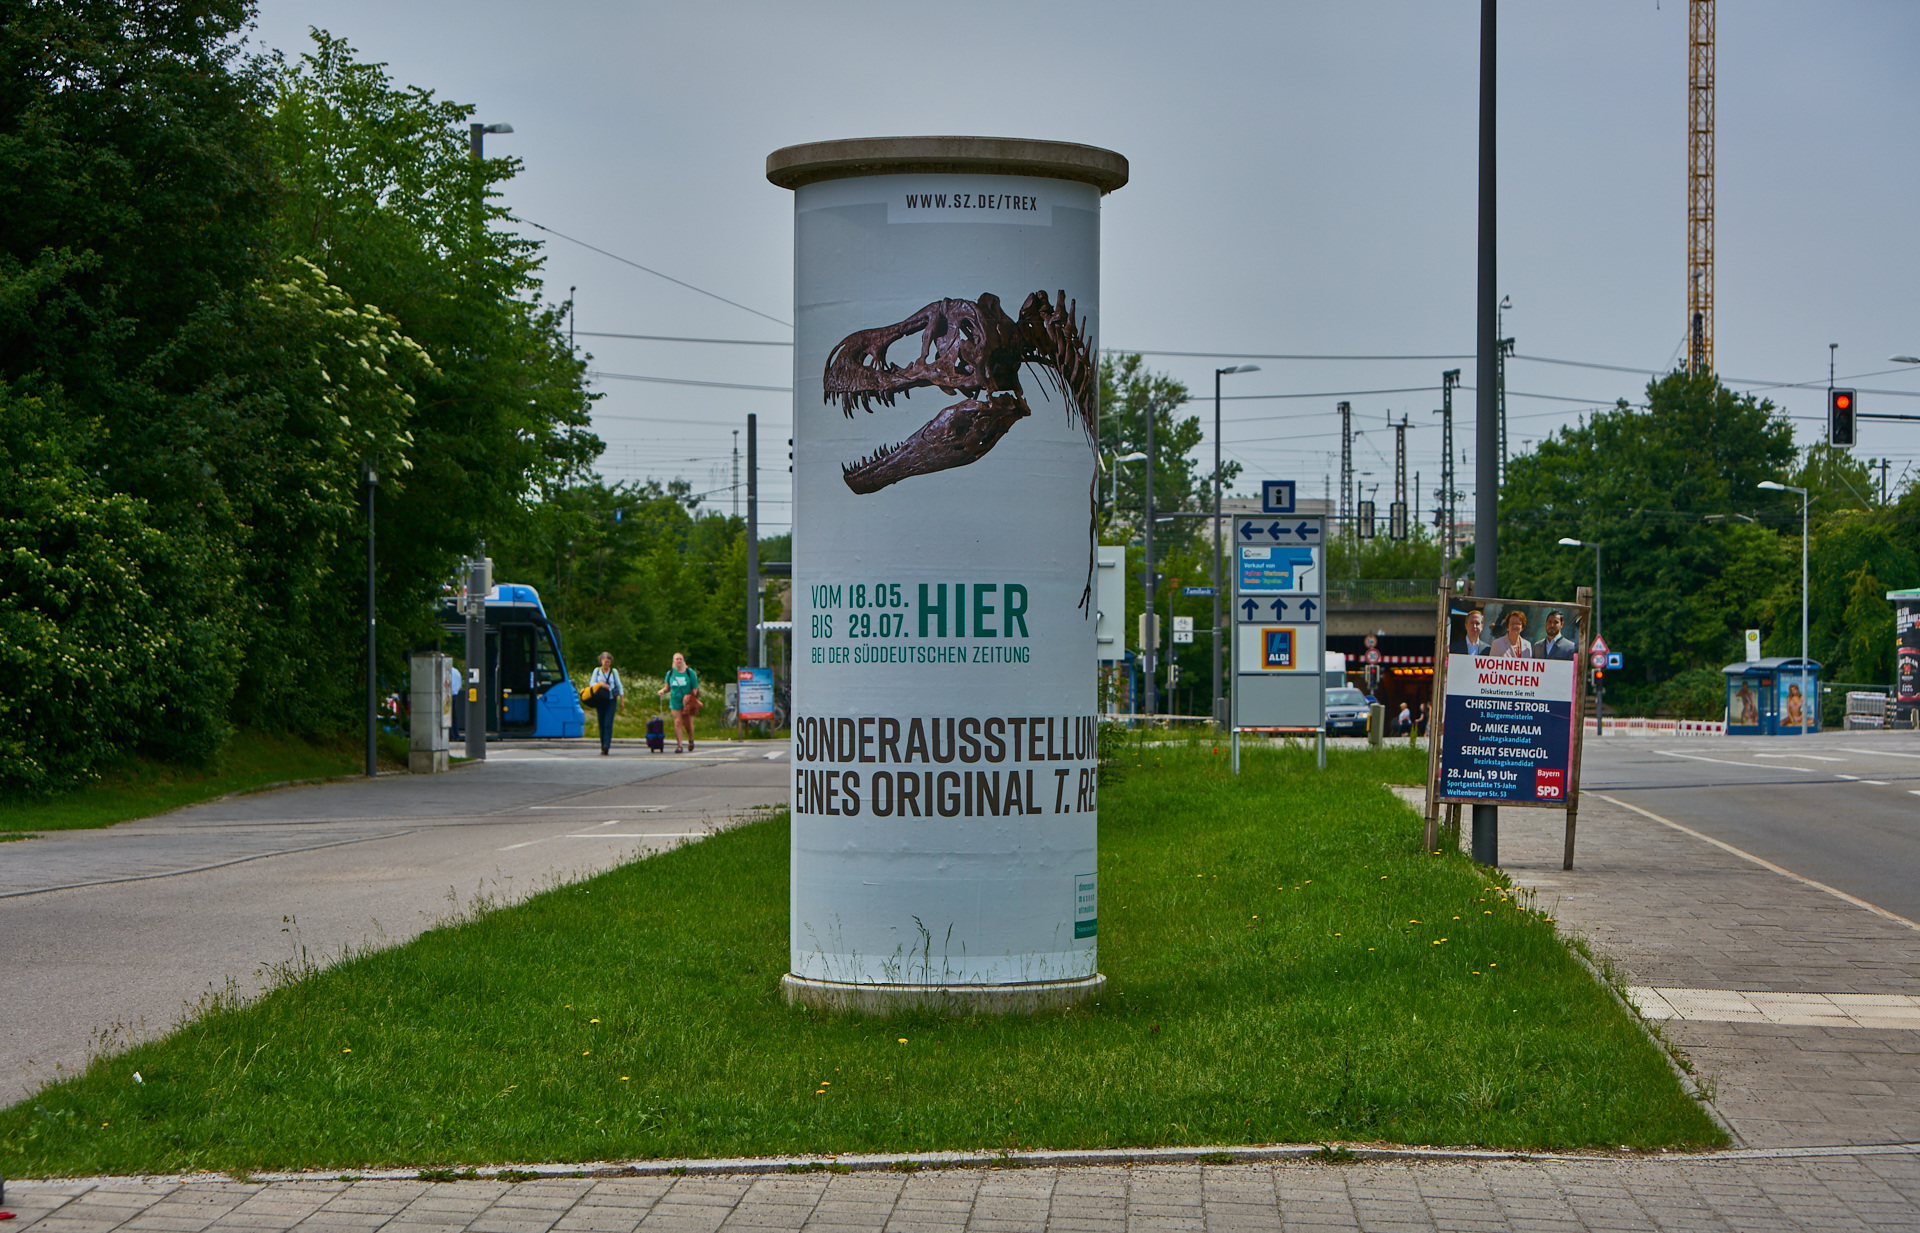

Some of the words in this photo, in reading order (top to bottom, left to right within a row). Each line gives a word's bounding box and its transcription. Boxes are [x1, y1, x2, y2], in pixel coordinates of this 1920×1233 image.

[906, 194, 1037, 211] WWW.SZ.DE/TREX
[811, 584, 842, 609] VOM
[849, 583, 909, 609] 18.05.
[918, 583, 1030, 638] HIER
[811, 614, 833, 638] BIS
[848, 613, 909, 638] 29.07.
[811, 647, 825, 664] BEI
[828, 647, 850, 663] DER
[854, 643, 967, 664] SÜDDEUTSCHEN
[972, 646, 1030, 664] ZEITUNG
[1269, 653, 1289, 661] ALDI
[1475, 658, 1529, 672] WOHNEN
[1532, 661, 1545, 673] IN
[1595, 656, 1604, 664] 30
[1478, 671, 1539, 687] MÜNCHEN
[1480, 688, 1513, 696] Diskutieren
[1465, 699, 1513, 710] CHRISTINE
[1514, 702, 1550, 712] STROBL
[1486, 712, 1533, 720] Bürgermeisterin
[1470, 723, 1483, 732] Dr.
[1485, 723, 1509, 733] MIKE
[1510, 725, 1542, 735] MALM
[1478, 735, 1531, 744] Landtagskandidat
[1461, 745, 1497, 756] SERHAT
[1498, 747, 1548, 759] SEVENGÜL
[1473, 758, 1534, 767] Bezirkstagskandidat
[1447, 768, 1461, 778] 28.
[1462, 769, 1485, 781] Juni,
[1486, 770, 1498, 779] 19
[1500, 770, 1518, 781] Uhr
[1537, 769, 1560, 778] Bayern
[1447, 780, 1493, 789] Sportgaststätte
[796, 769, 860, 817] EINES
[872, 769, 1042, 818] ORIGINAL
[1054, 768, 1070, 814] T.
[1076, 767, 1097, 813] RE
[1447, 789, 1488, 798] Weltenburger
[1537, 786, 1559, 796] SPD
